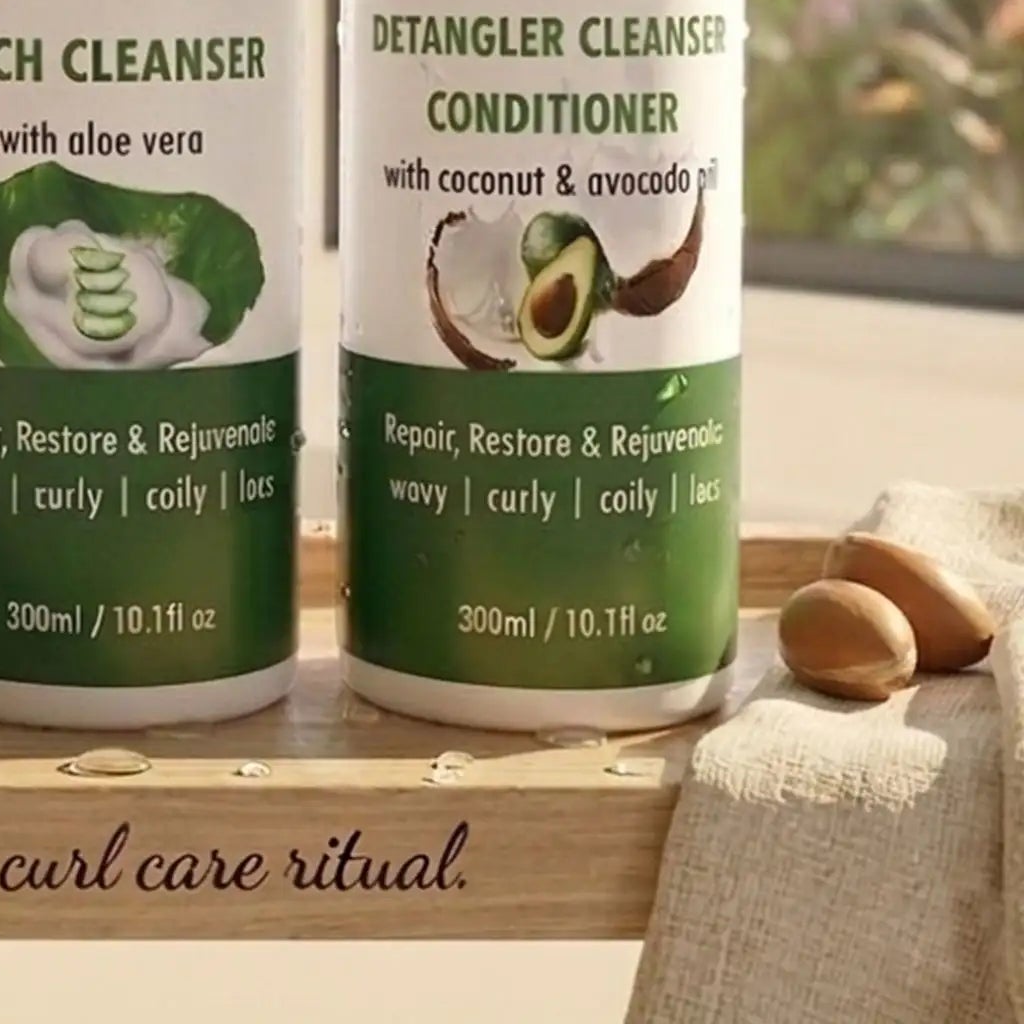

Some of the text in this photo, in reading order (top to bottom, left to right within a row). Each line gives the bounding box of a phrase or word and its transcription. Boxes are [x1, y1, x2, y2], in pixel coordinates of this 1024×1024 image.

[373, 13, 726, 58] DETANGLER CLEANSER
[62, 37, 265, 82] CLEANSER
[427, 90, 679, 135] CONDITIONER
[0, 121, 204, 157] with aloe vera
[384, 157, 430, 191] with
[438, 165, 545, 196] coconut
[555, 164, 577, 196] &
[17, 420, 118, 456] Restore
[128, 424, 147, 455] &
[469, 423, 571, 458] Restore
[581, 426, 601, 458] &
[34, 476, 103, 520] curly
[146, 474, 208, 515] coily
[487, 478, 556, 522] curly
[600, 477, 658, 518] coily
[6, 601, 81, 634] 300ml
[192, 609, 216, 631] oz
[457, 604, 535, 638] 300ml
[642, 611, 668, 634] oz
